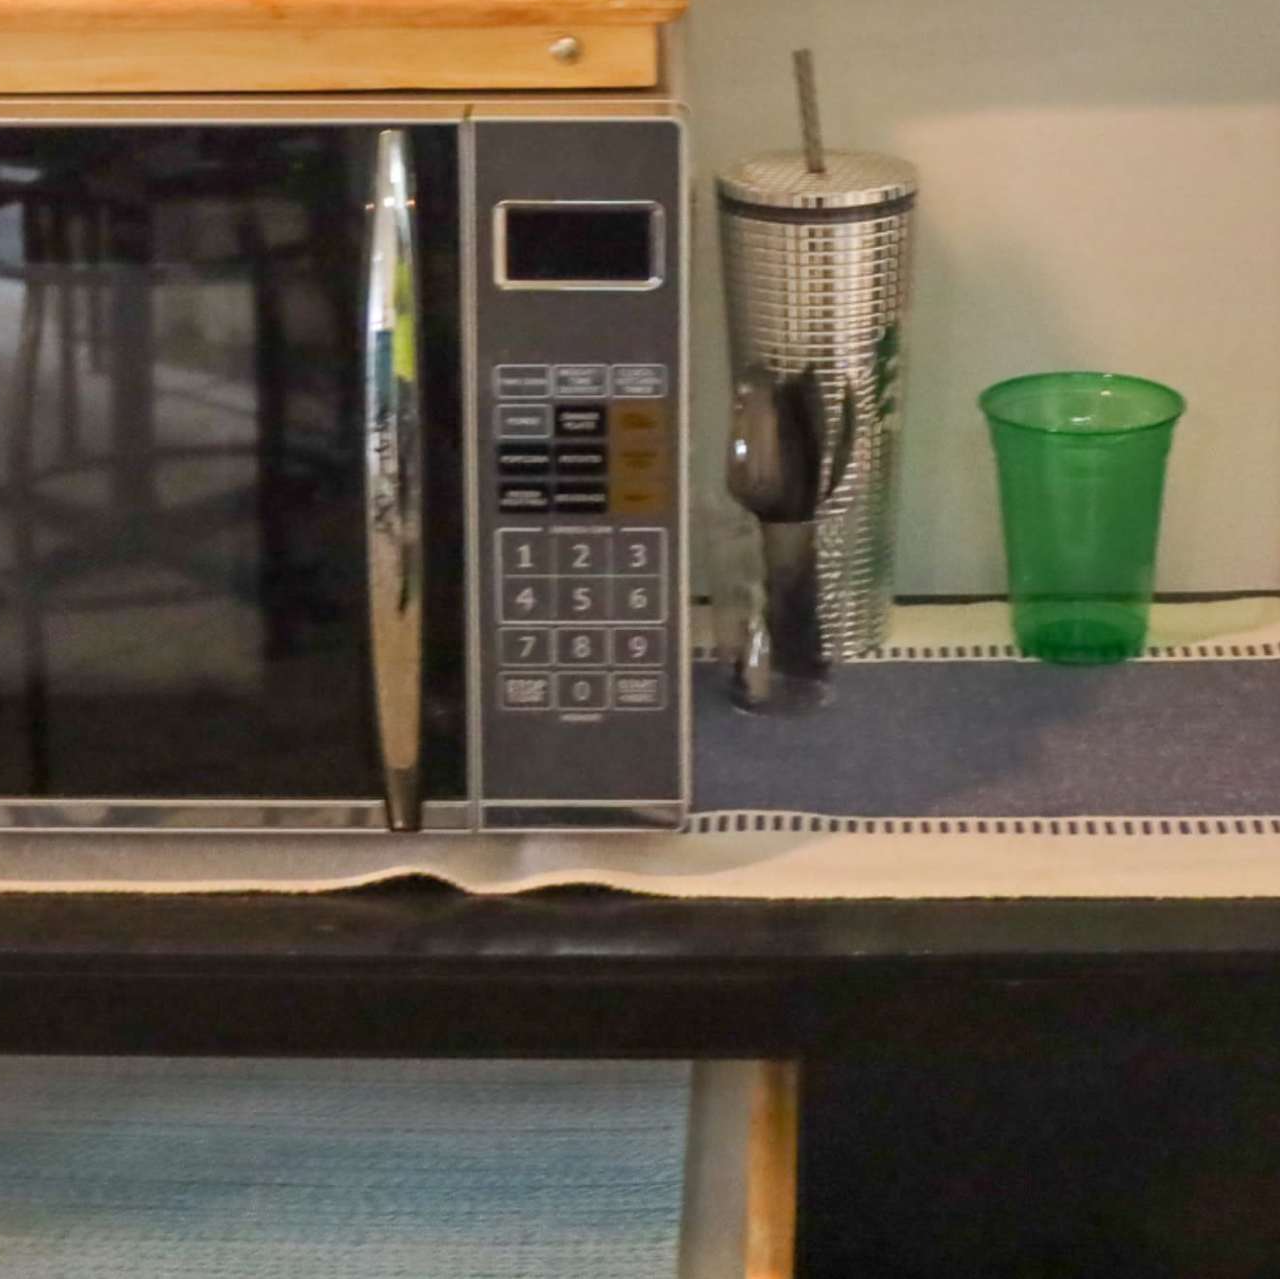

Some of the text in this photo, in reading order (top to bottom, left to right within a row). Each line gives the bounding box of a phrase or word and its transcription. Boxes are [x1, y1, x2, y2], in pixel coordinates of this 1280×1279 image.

[517, 544, 647, 568] 1 2 3
[515, 587, 647, 611] 4 5 6
[519, 635, 647, 658] 7 8 9
[573, 681, 590, 701] 0
